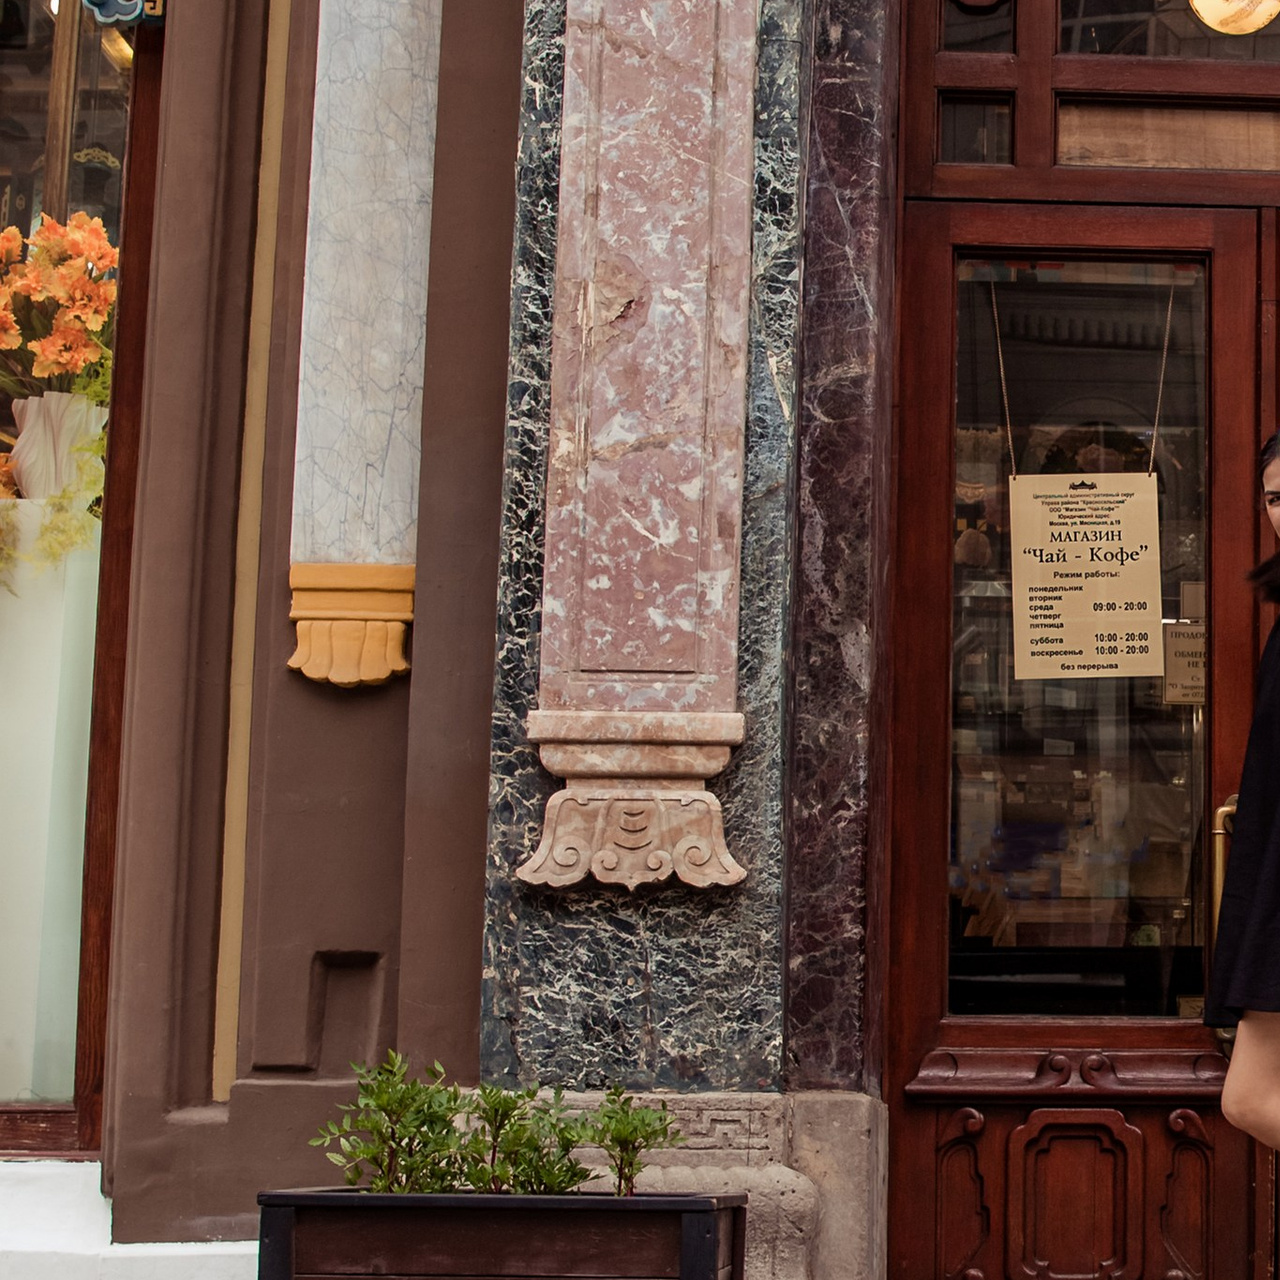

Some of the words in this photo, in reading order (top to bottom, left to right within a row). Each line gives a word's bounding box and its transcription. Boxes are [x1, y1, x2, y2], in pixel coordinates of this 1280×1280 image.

[1050, 530, 1122, 543] МАГАЗИН
[1053, 571, 1082, 579] Режим
[1084, 571, 1121, 580] работы:
[1028, 585, 1083, 593] понедельник
[1029, 604, 1054, 612] среда
[1093, 602, 1117, 612] 09:00
[1124, 602, 1148, 611] 20:00
[1029, 613, 1062, 621] четверг
[1030, 622, 1064, 630] пятница
[1030, 636, 1064, 645] суббота
[1094, 633, 1118, 643] 10:00
[1125, 632, 1149, 642] 20:00
[1030, 649, 1084, 657] воскресенье
[1095, 646, 1118, 655] 10:00
[1126, 645, 1149, 655] 20:00
[1060, 663, 1075, 671] без
[1077, 663, 1119, 672] перерыва
[1187, 661, 1200, 669] НЕ
